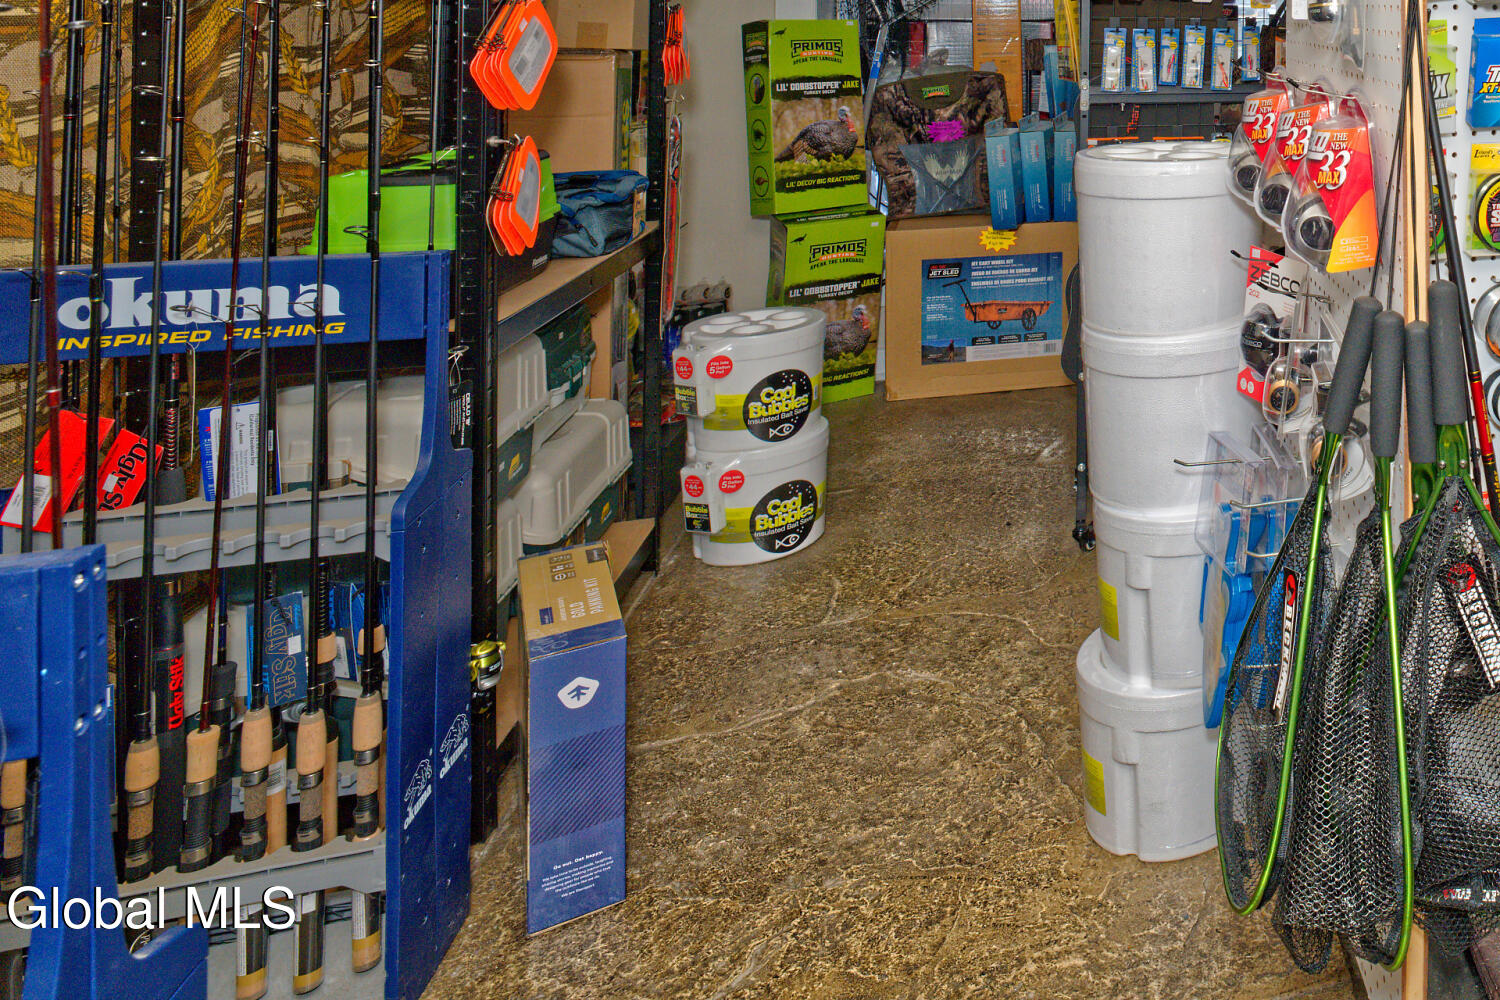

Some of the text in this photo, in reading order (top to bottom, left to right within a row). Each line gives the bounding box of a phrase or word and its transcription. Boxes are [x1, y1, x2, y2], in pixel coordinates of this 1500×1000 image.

[793, 40, 842, 53] PRIMOS
[842, 79, 860, 89] JAKE
[1479, 83, 1497, 94] XT
[1259, 106, 1274, 115] NEW
[1260, 99, 1273, 108] THE
[1250, 111, 1276, 141] 33
[1251, 127, 1269, 141] MAX
[1333, 131, 1349, 141] THE
[1330, 139, 1351, 151] NEW
[1314, 149, 1352, 190] 33
[1317, 169, 1340, 185] MAX
[811, 241, 866, 259] PRIMOS
[929, 268, 960, 277] JET SLED
[861, 277, 880, 289] JAKE
[57, 275, 347, 332] okuma
[57, 320, 347, 352] INSPIRED FISHING
[760, 382, 797, 404] Cool
[748, 393, 811, 420] Bubbles
[747, 413, 780, 426] Insulated
[780, 410, 794, 420] Bait
[766, 492, 803, 514] Cool
[755, 503, 815, 531] Bubbles
[168, 654, 185, 730] Ugly Stik
[439, 736, 469, 779] okuma
[403, 787, 433, 830] okuma
